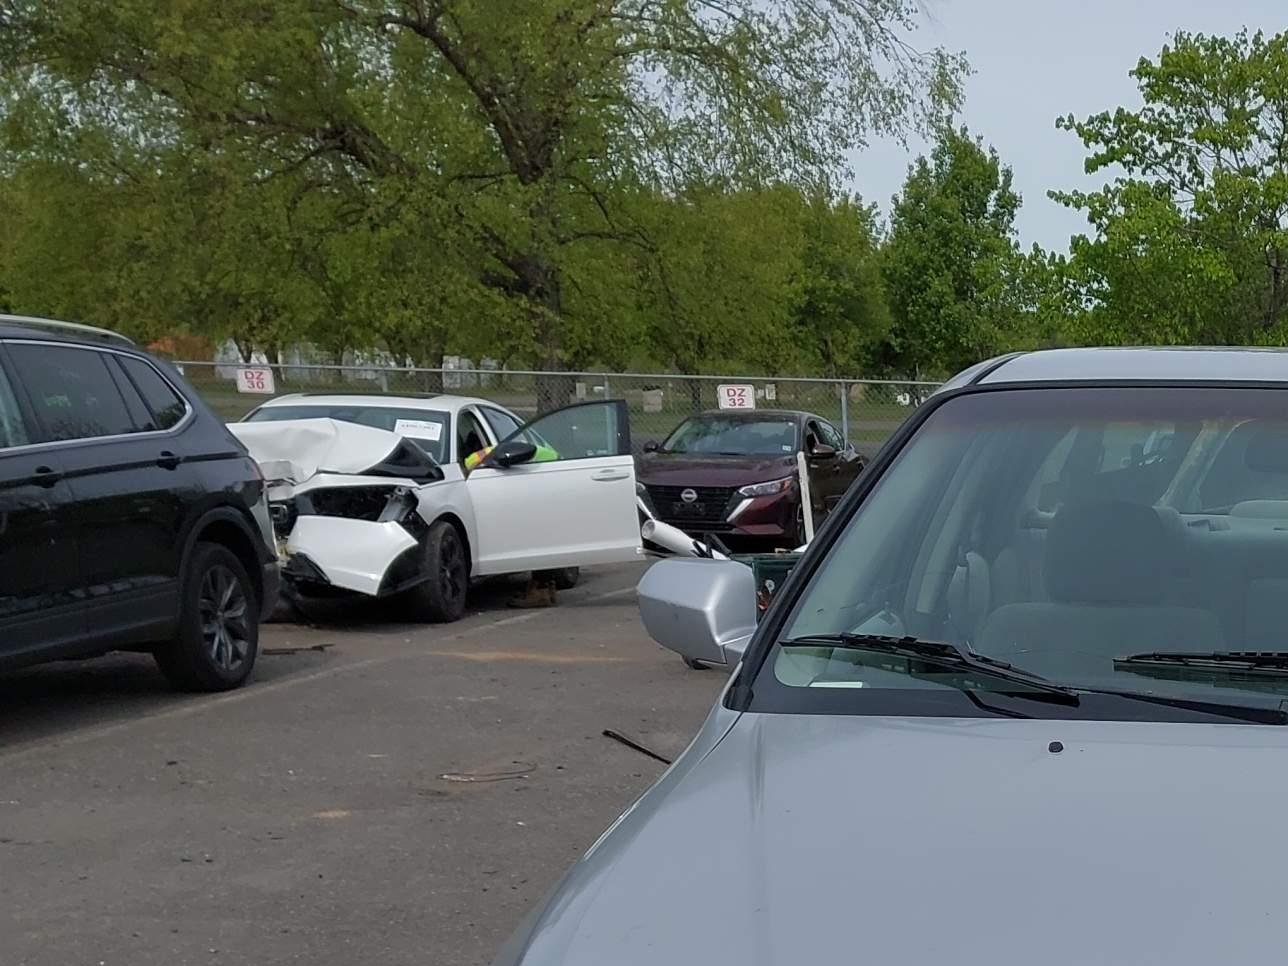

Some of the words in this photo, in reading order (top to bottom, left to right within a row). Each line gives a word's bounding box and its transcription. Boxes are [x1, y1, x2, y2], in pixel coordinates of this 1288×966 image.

[244, 370, 264, 380] DZ
[247, 380, 264, 389] 30
[726, 388, 746, 397] DZ
[729, 397, 745, 406] 32
